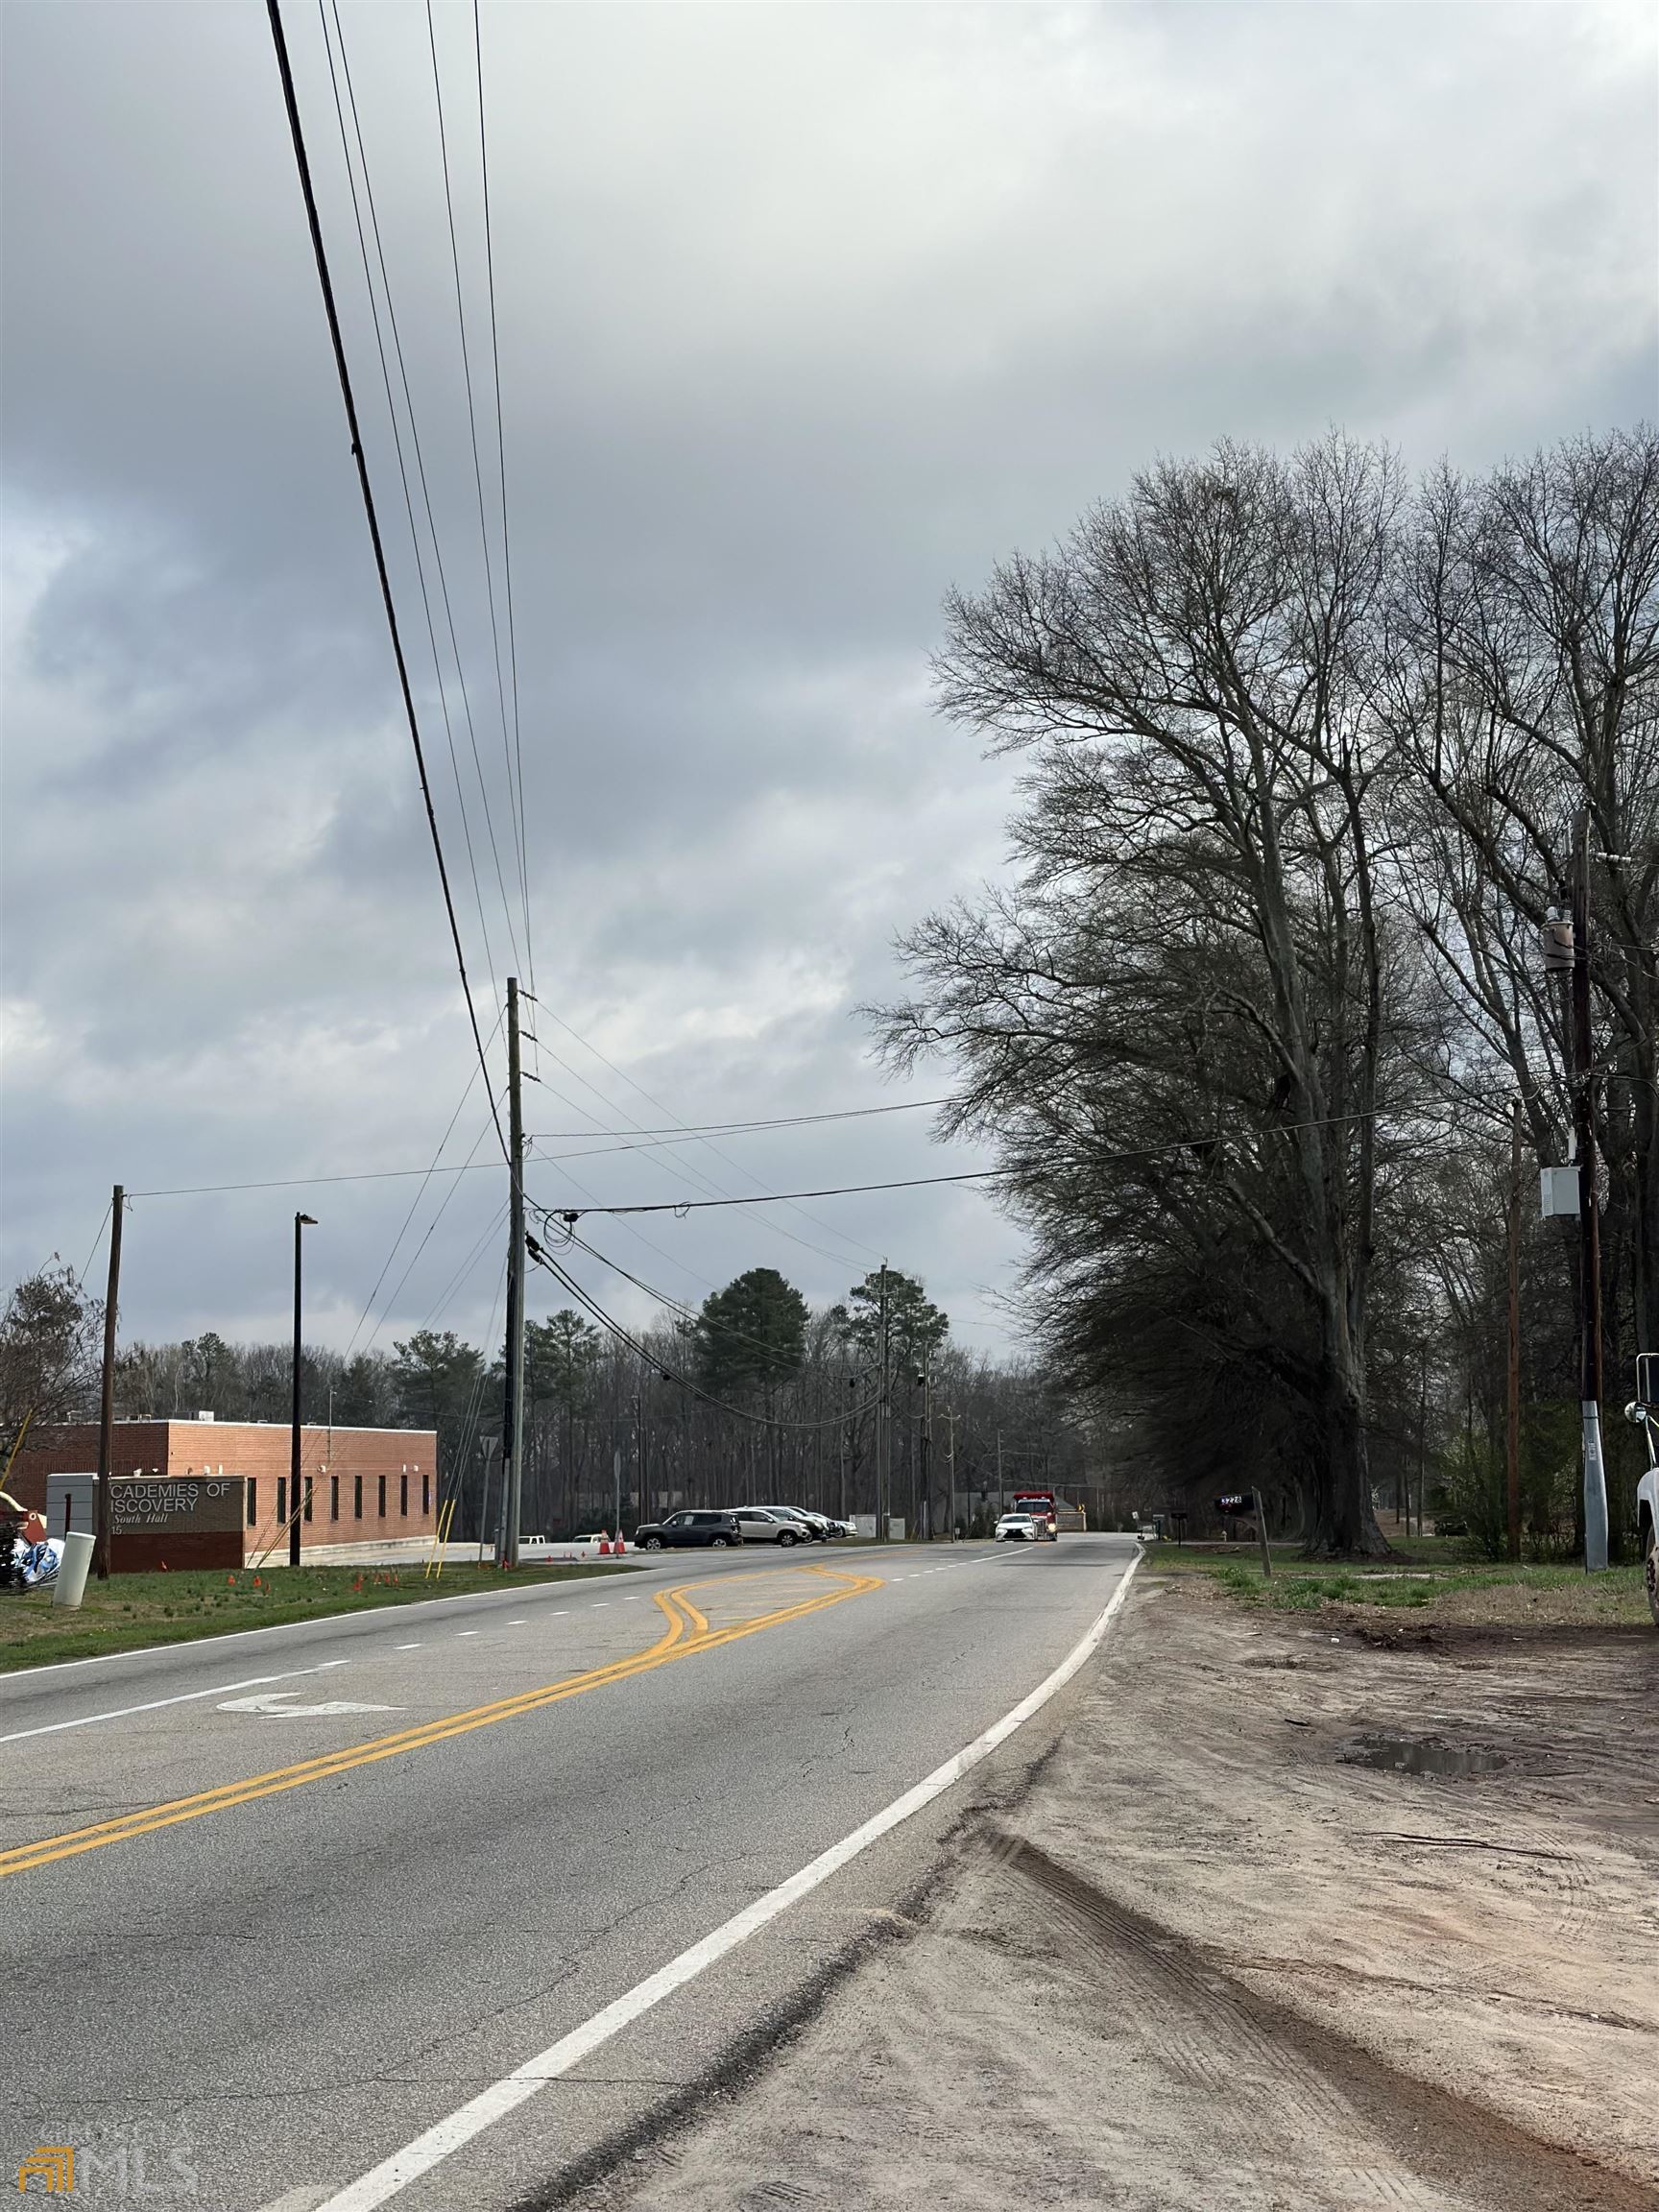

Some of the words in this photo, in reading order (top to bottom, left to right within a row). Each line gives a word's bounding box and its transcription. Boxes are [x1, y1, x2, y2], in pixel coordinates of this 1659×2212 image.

[110, 1483, 199, 1499] CADEMIES
[206, 1482, 230, 1497] OF
[110, 1498, 199, 1513] ISCOVERY
[114, 1513, 141, 1524] South
[146, 1513, 168, 1523] Hall
